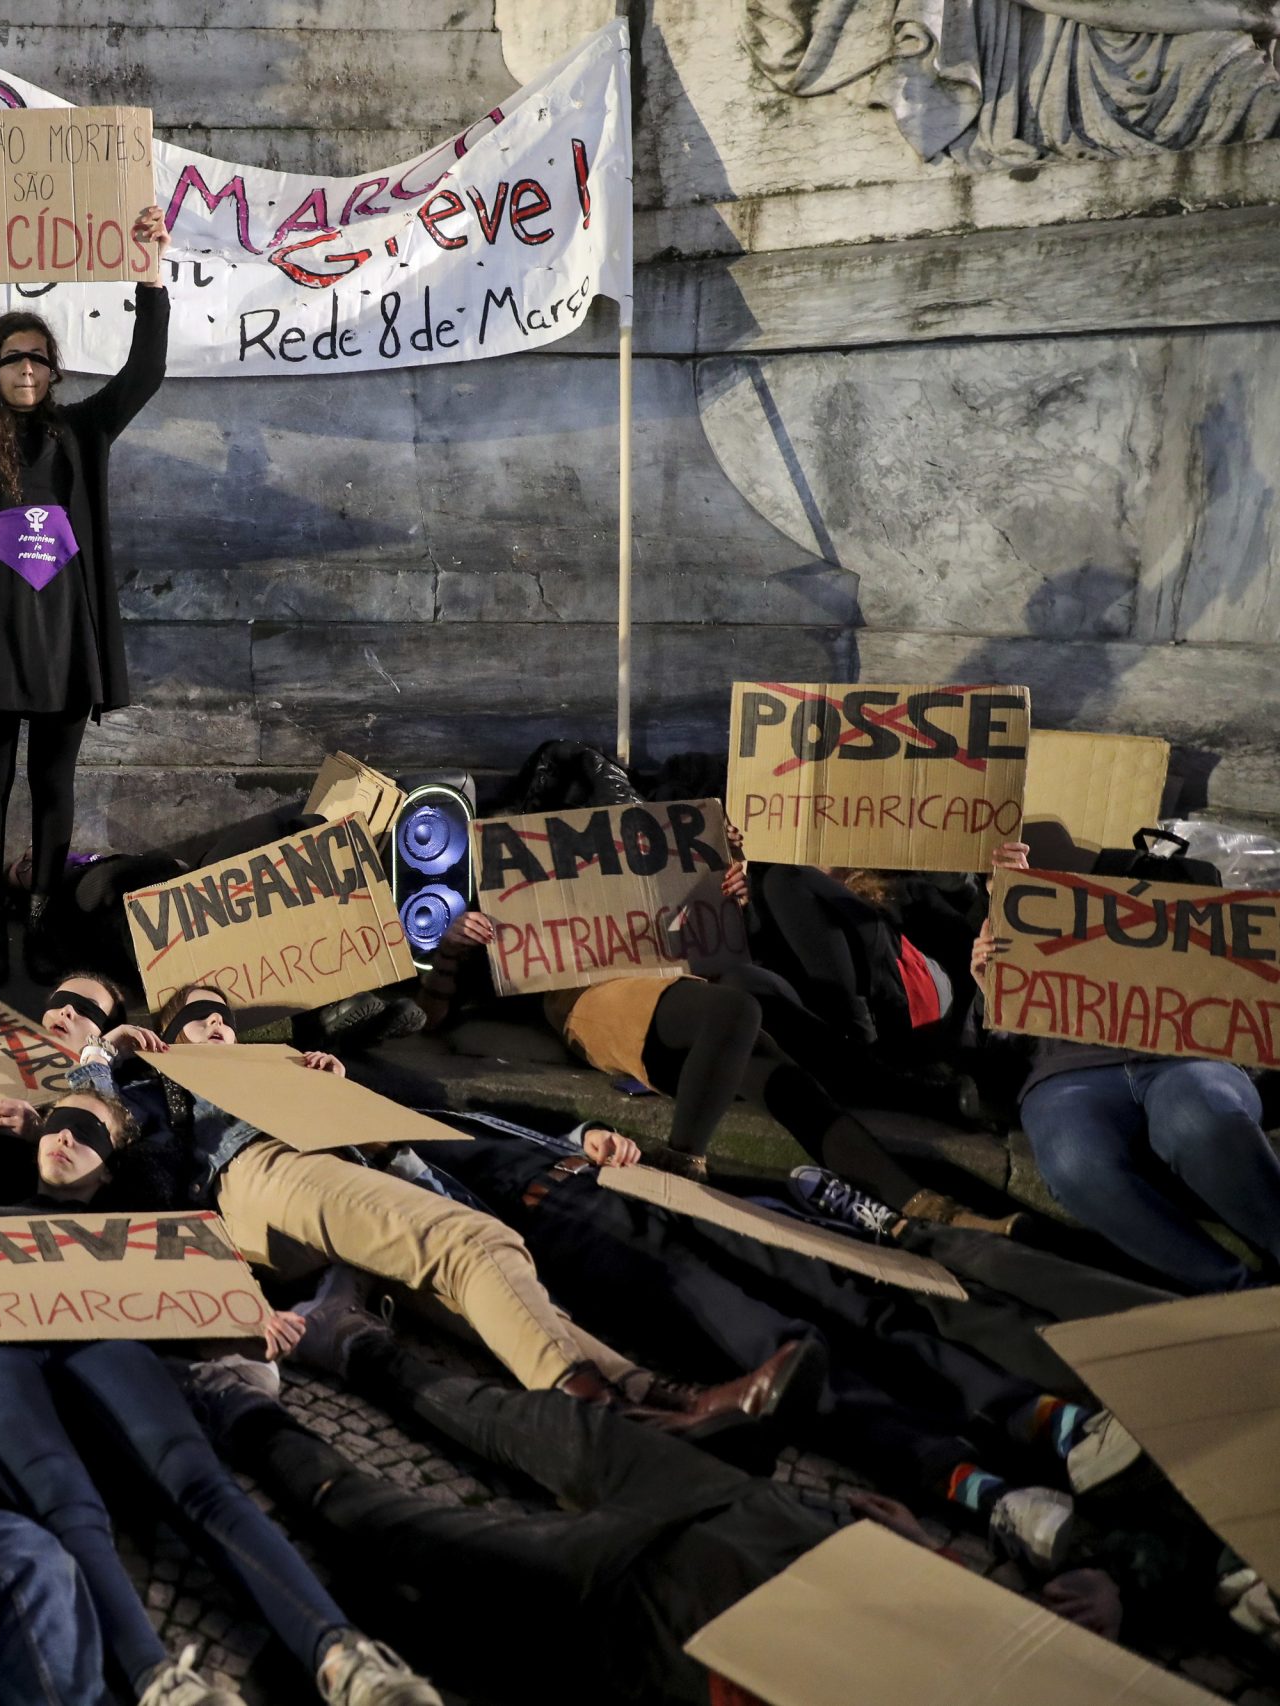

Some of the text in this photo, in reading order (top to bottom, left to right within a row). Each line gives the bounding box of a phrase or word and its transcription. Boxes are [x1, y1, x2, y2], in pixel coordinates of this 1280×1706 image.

[13, 172, 55, 202] SÃO
[239, 276, 589, 363] Rede 8 de Março
[739, 690, 1028, 762] POSSE
[128, 819, 386, 951] VINGANÇA
[479, 804, 728, 891] AMOR
[496, 899, 746, 981] PATRIARCADO
